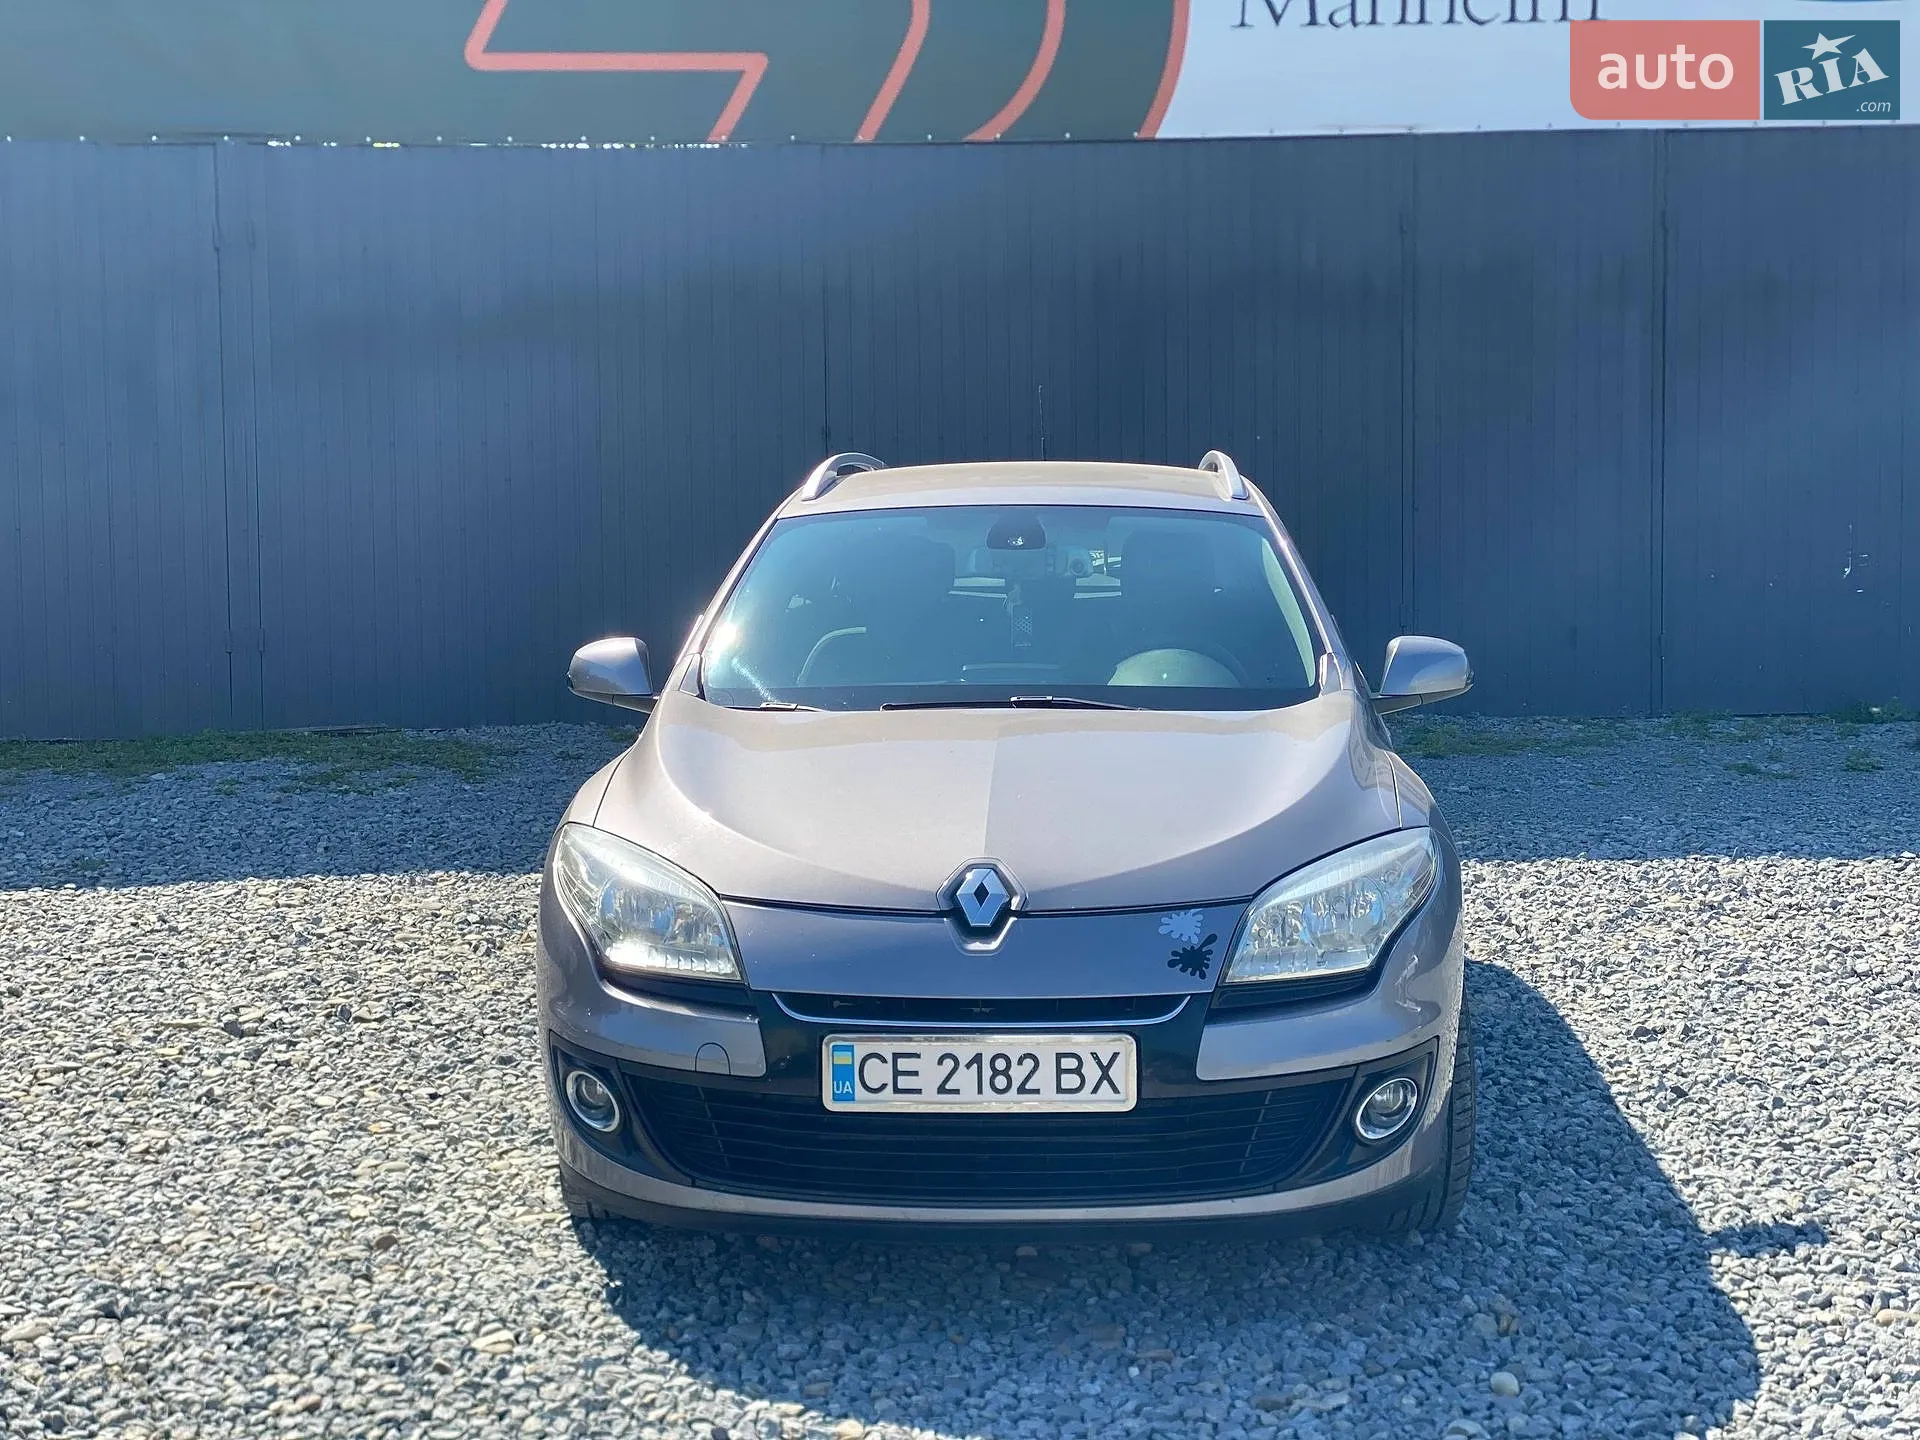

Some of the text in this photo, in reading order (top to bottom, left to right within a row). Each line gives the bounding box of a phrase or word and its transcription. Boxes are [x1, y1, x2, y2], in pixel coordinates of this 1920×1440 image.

[833, 1080, 853, 1095] UA
[858, 1051, 1121, 1095] CE 2182 BX
